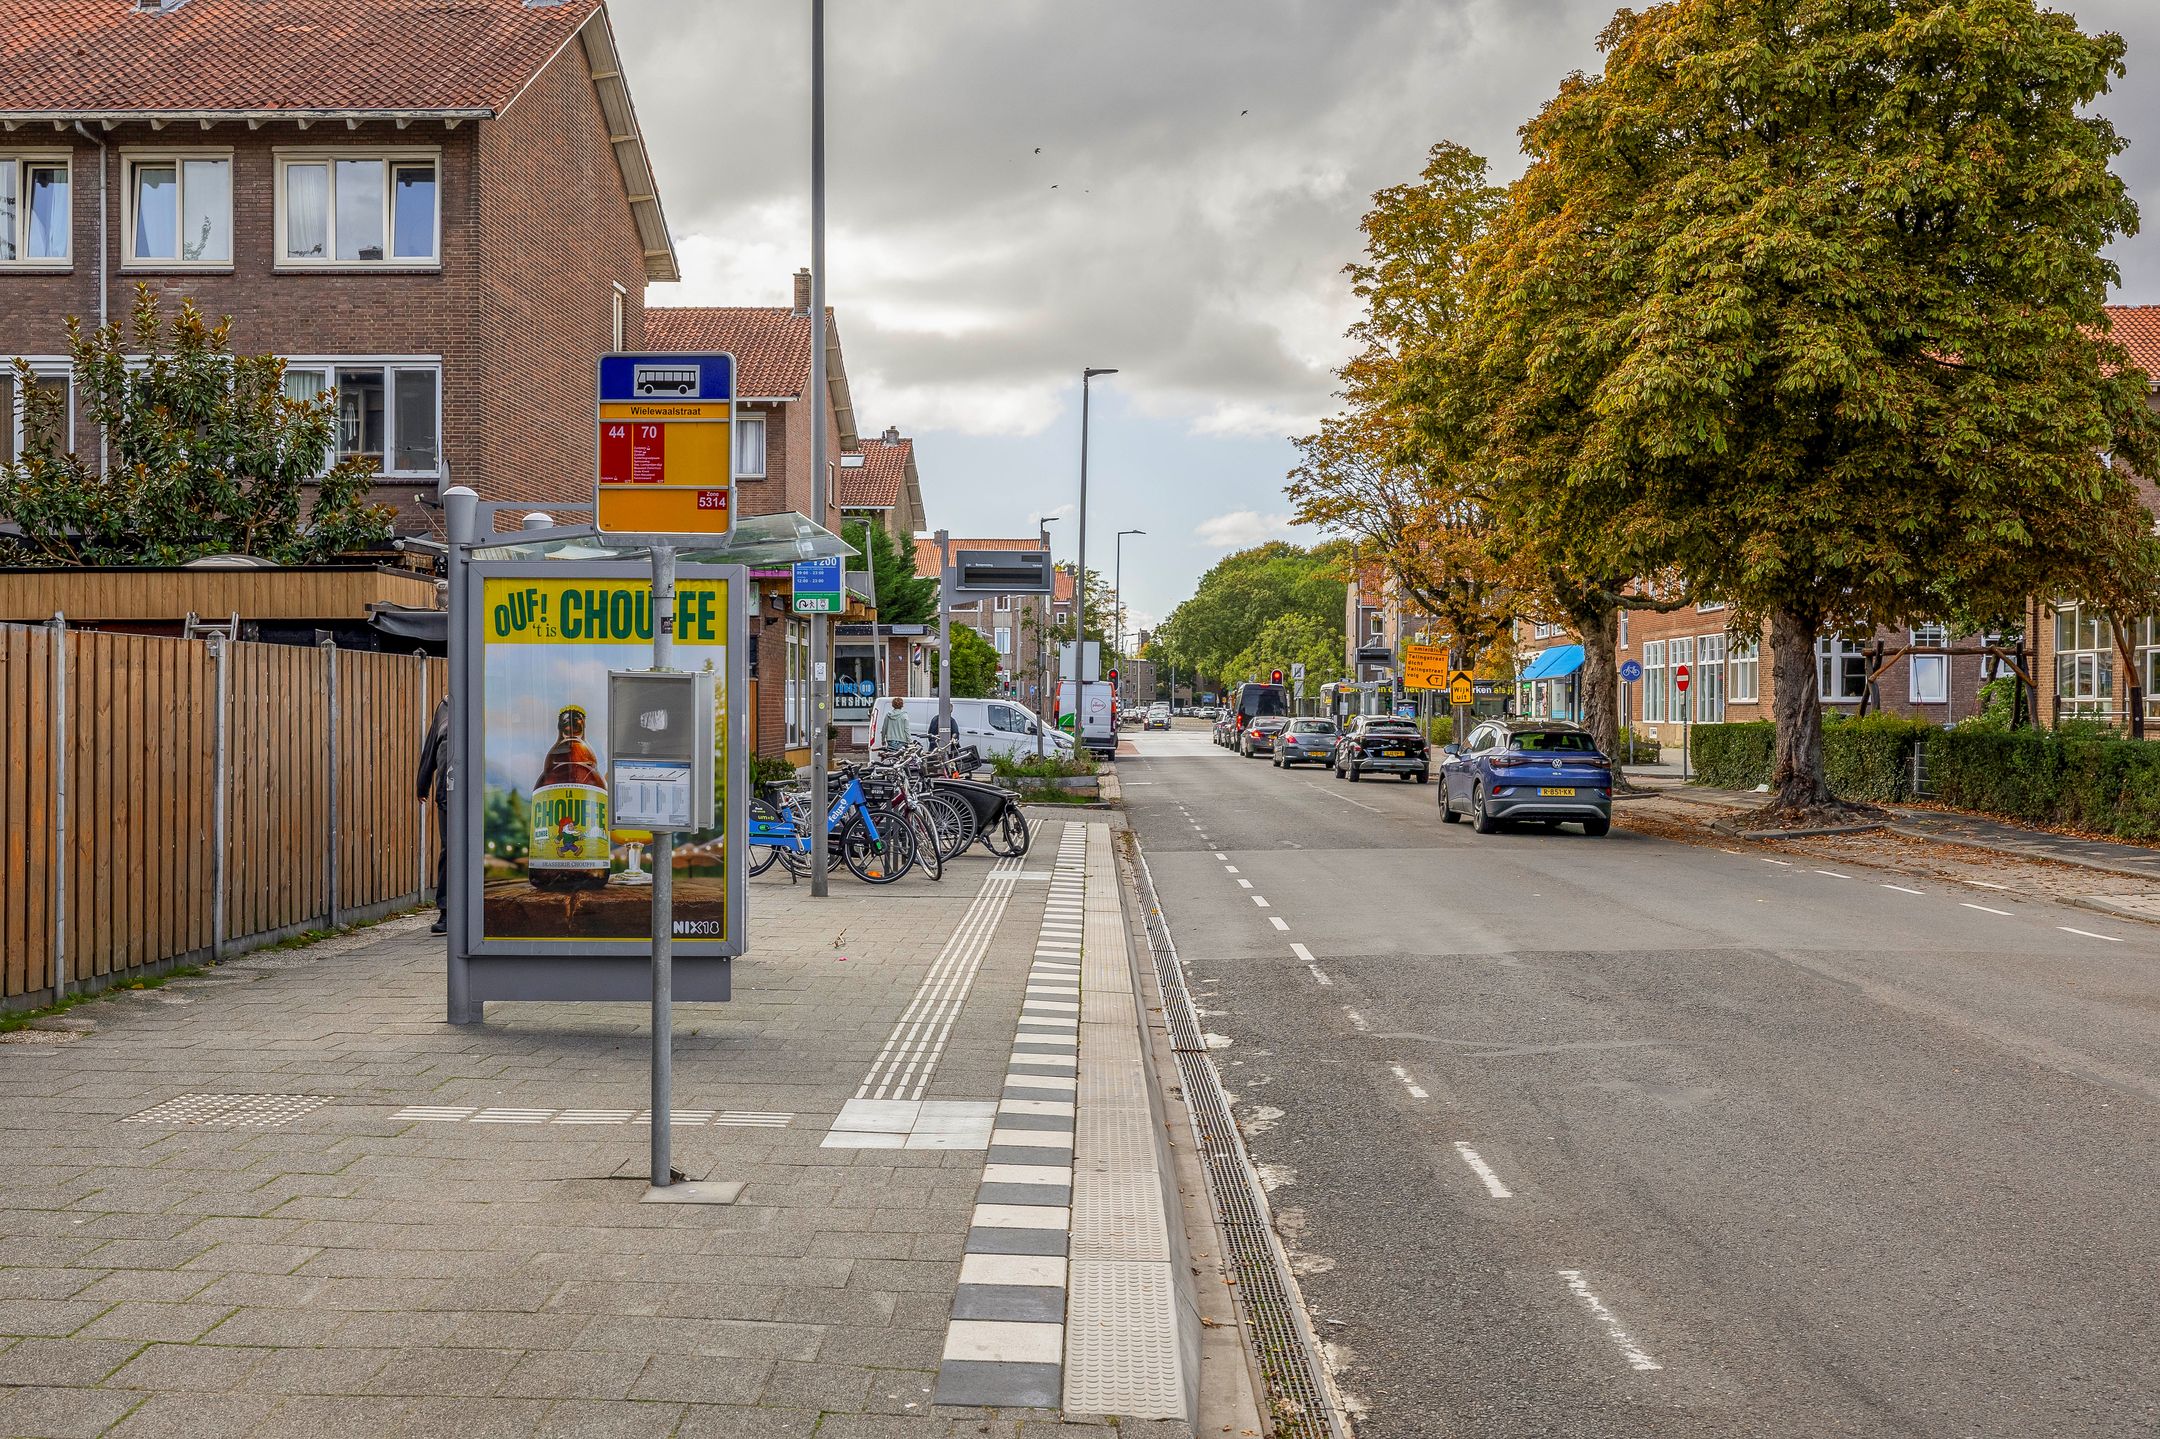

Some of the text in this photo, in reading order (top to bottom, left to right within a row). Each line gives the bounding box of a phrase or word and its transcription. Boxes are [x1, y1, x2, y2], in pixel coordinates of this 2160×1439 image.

[630, 406, 701, 416] Wielewaalstraat
[608, 425, 626, 439] 44
[641, 425, 657, 439] 70
[698, 496, 727, 508] 5314
[494, 588, 548, 637] OUF!
[546, 623, 557, 638] is
[560, 588, 716, 640] CHOUFE
[1408, 653, 1445, 662] Talingstraat
[1453, 687, 1470, 695] Wijk
[1493, 686, 1506, 694] als
[835, 696, 874, 707] ERSHOP
[565, 789, 573, 799] LA
[534, 798, 606, 829] CHOUFFE
[673, 920, 720, 935] NIX18
